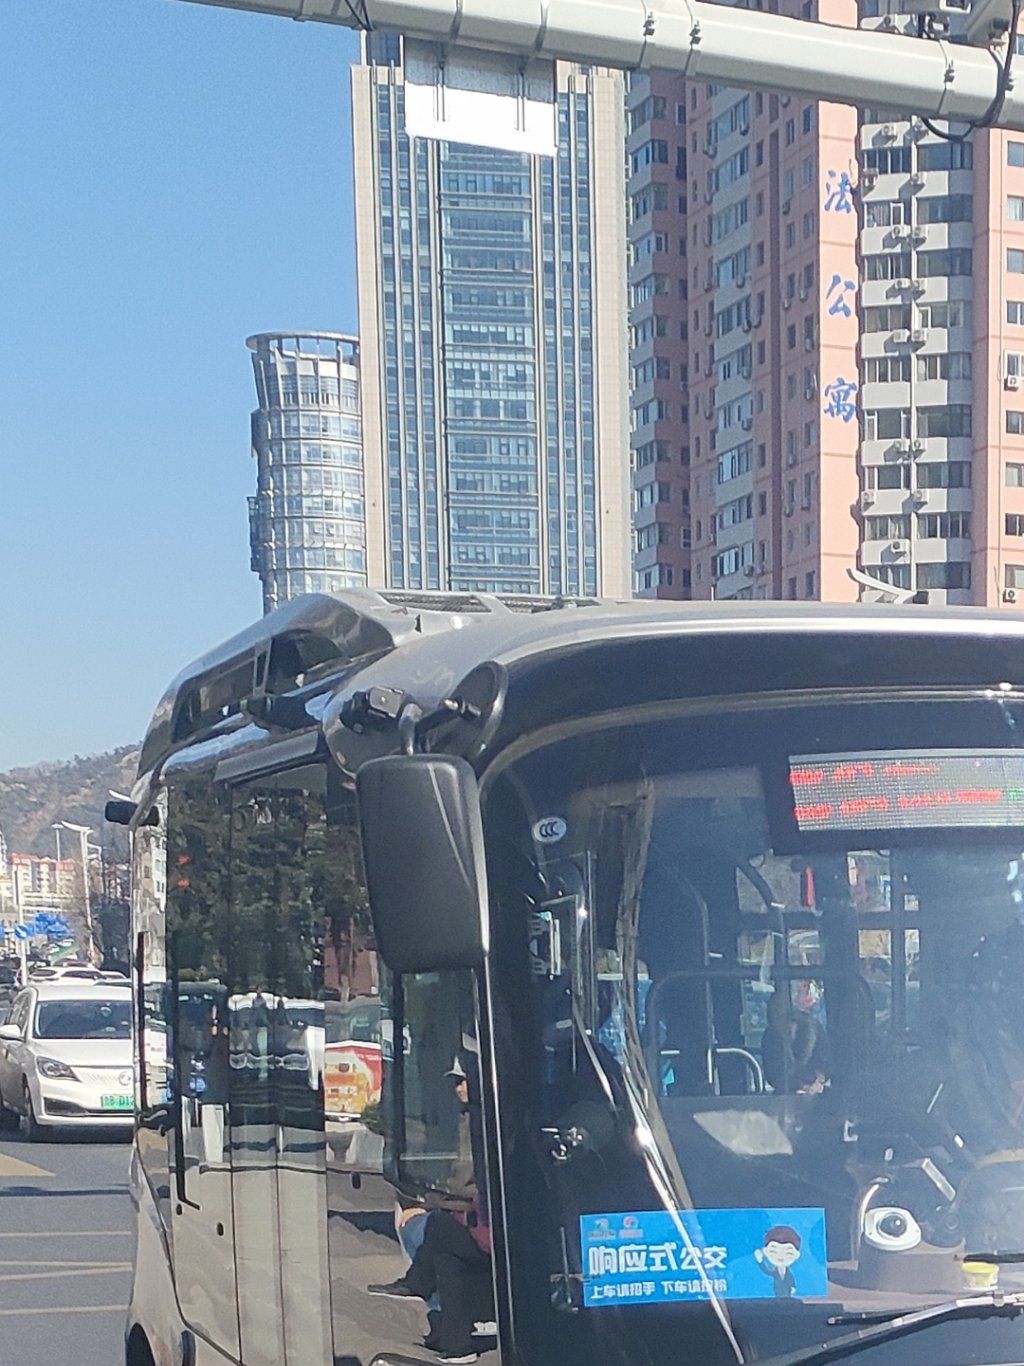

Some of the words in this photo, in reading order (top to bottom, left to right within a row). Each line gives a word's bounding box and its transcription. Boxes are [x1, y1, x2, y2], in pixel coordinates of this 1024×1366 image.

[588, 1241, 727, 1276] 响应式公交
